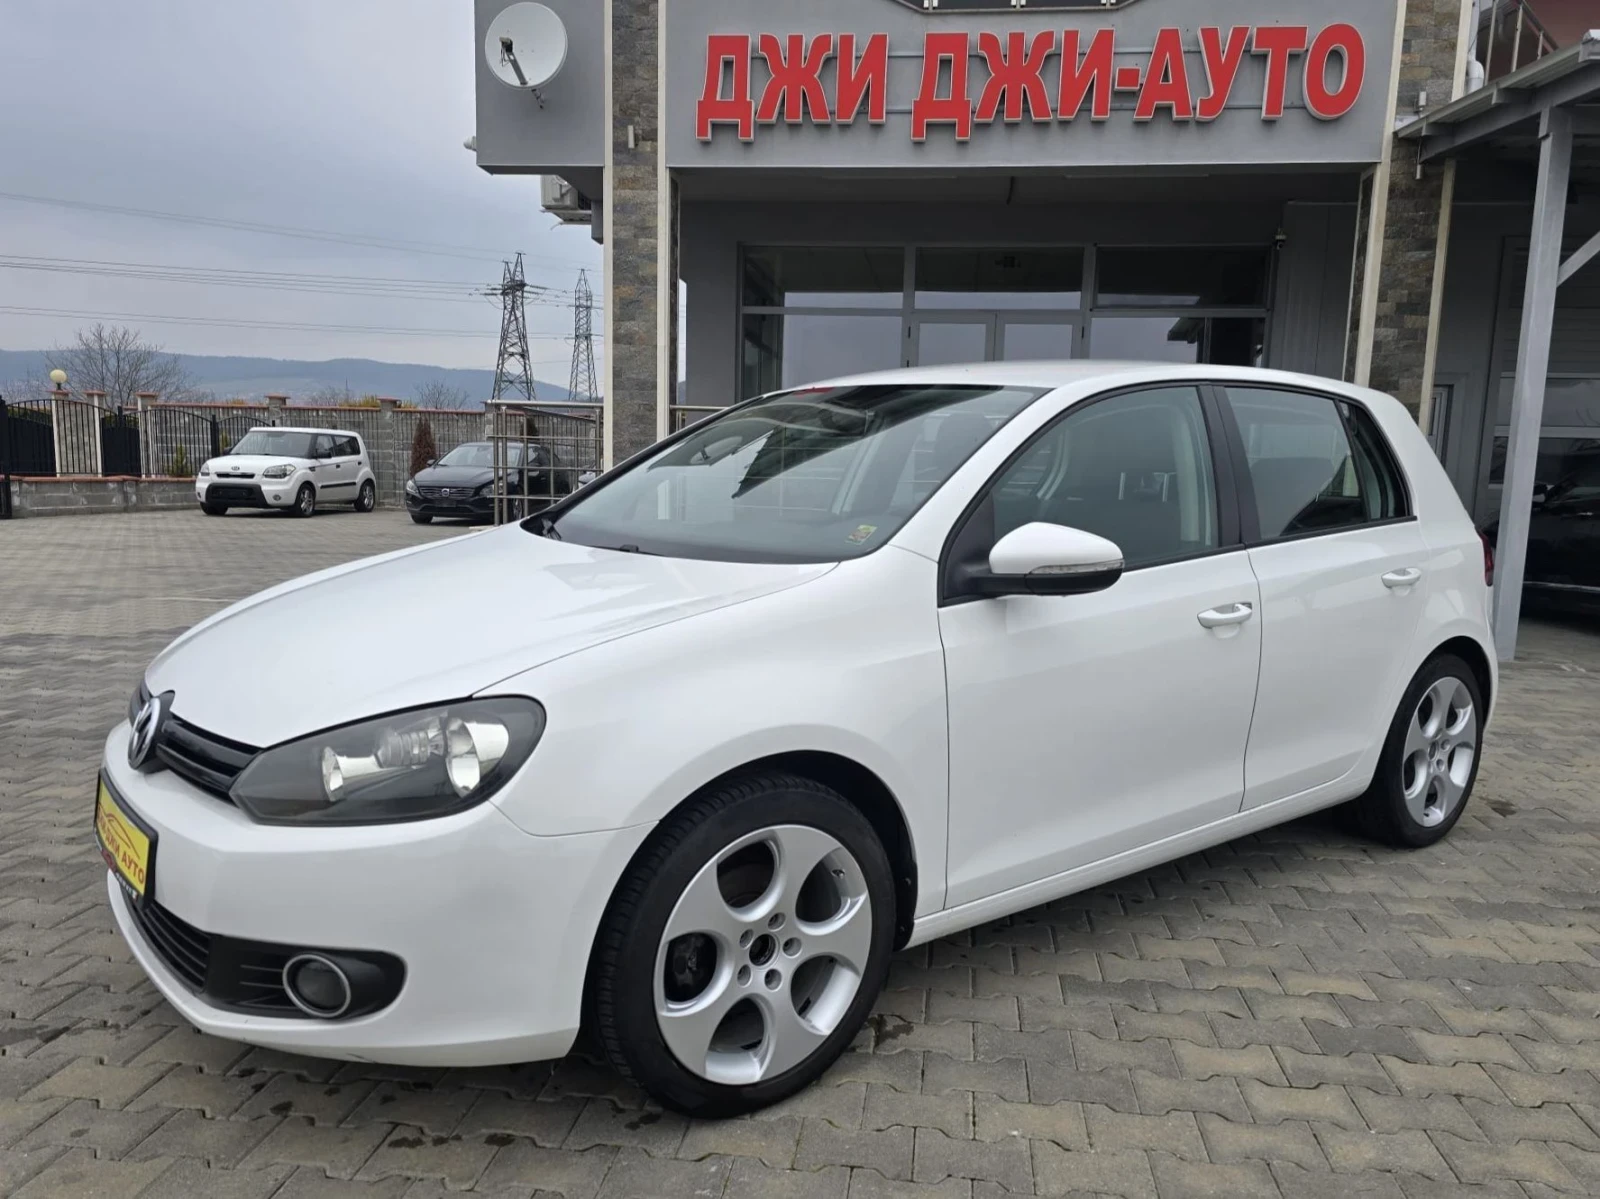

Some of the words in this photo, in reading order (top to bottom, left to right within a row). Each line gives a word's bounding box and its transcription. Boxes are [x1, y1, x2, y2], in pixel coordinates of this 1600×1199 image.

[695, 33, 888, 142] ДЖИ
[911, 22, 1366, 142] ДЖИ-АУТО
[121, 850, 145, 885] АУТО
